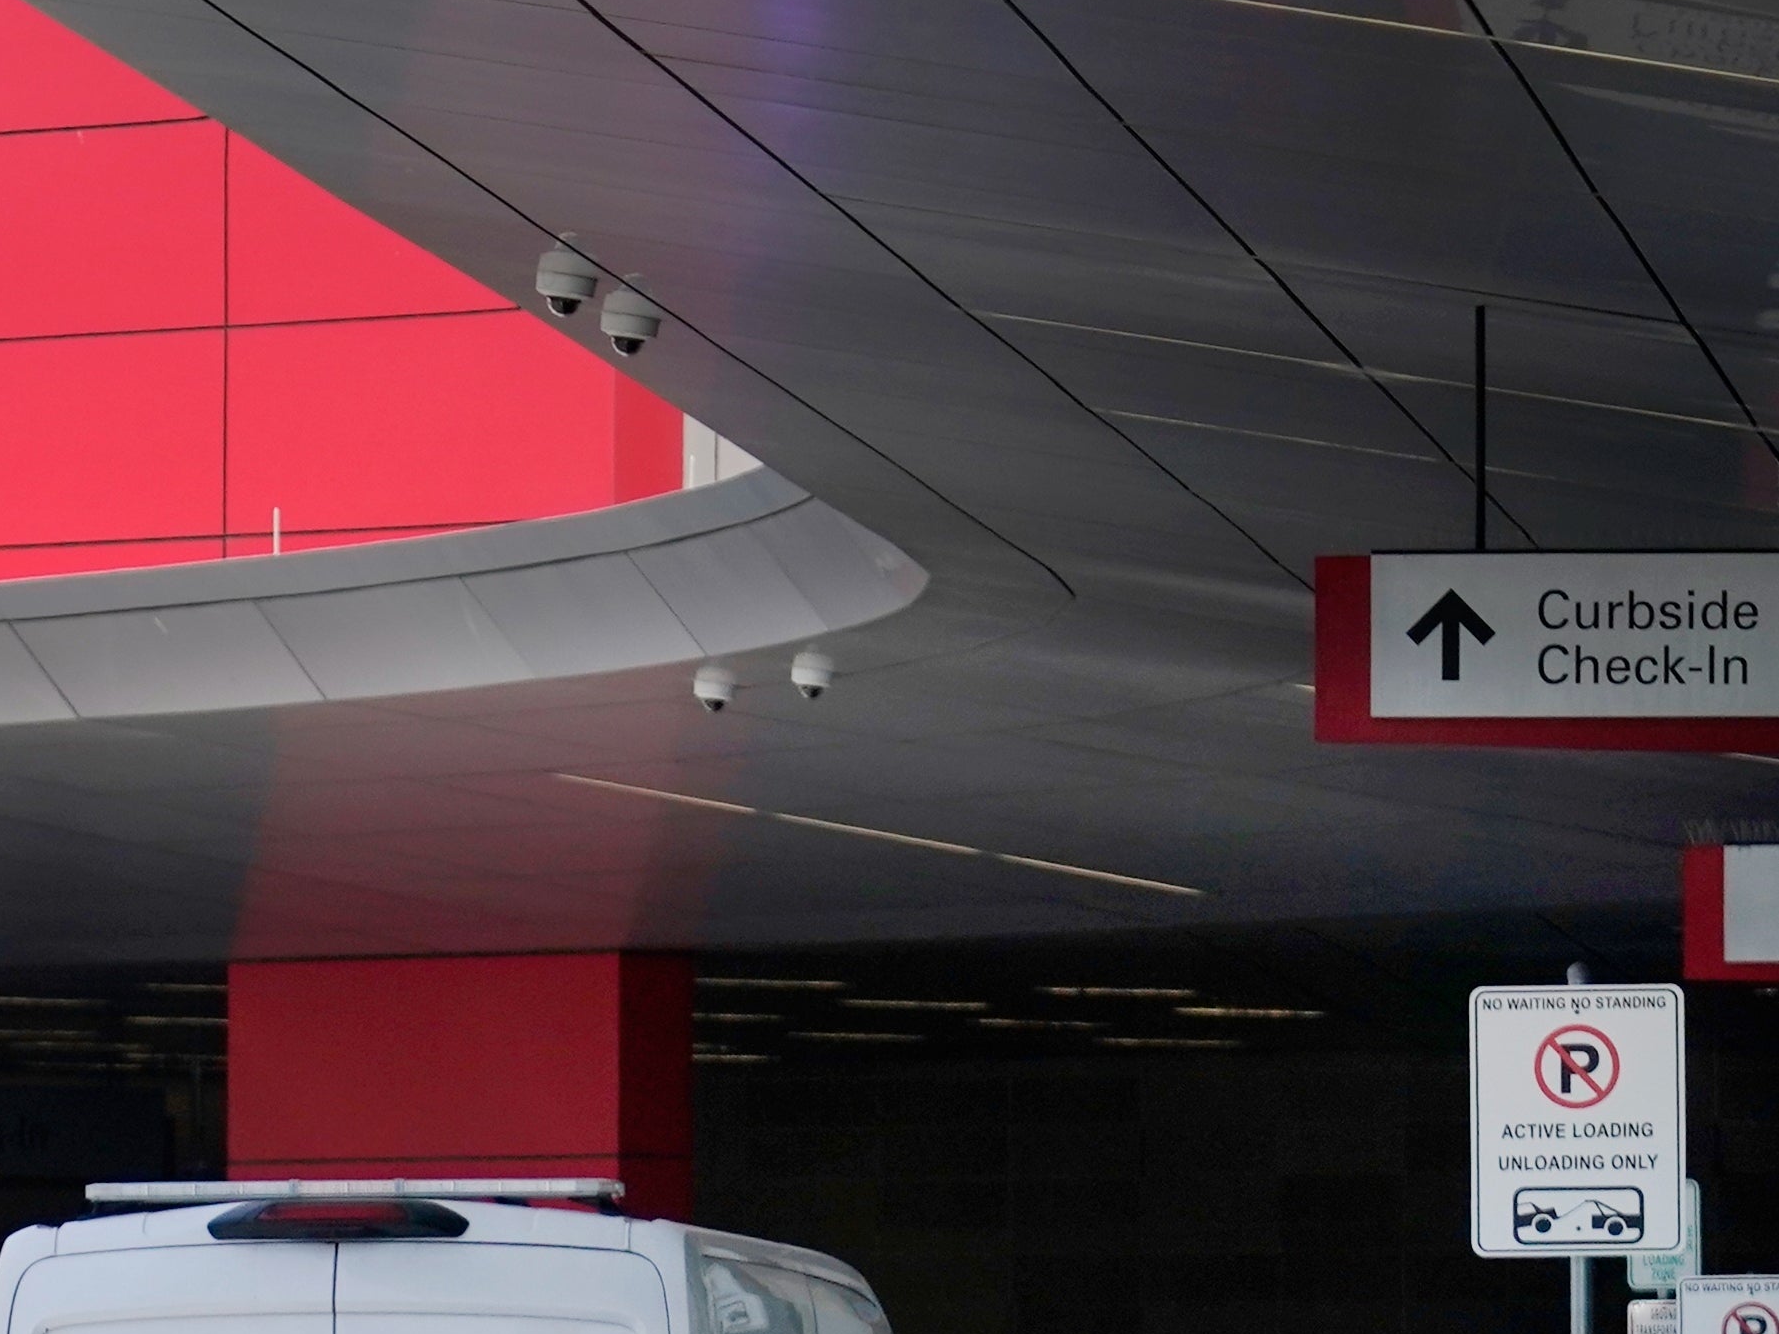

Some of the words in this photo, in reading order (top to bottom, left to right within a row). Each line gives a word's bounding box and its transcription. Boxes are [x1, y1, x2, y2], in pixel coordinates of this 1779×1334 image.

[1538, 588, 1760, 631] Curbside
[1538, 643, 1749, 686] Check-In
[1482, 998, 1502, 1010] NO
[1507, 997, 1566, 1010] WAITING
[1571, 996, 1591, 1009] NO
[1596, 995, 1667, 1009] STANDING
[1501, 1124, 1566, 1140] ACTIVE
[1573, 1122, 1654, 1139] LOADING
[1498, 1155, 1604, 1171] UNLOADING
[1611, 1154, 1659, 1170] ONLY
[1685, 1281, 1699, 1292] NO
[1702, 1281, 1744, 1292] WAITING
[1747, 1281, 1761, 1292] NO
